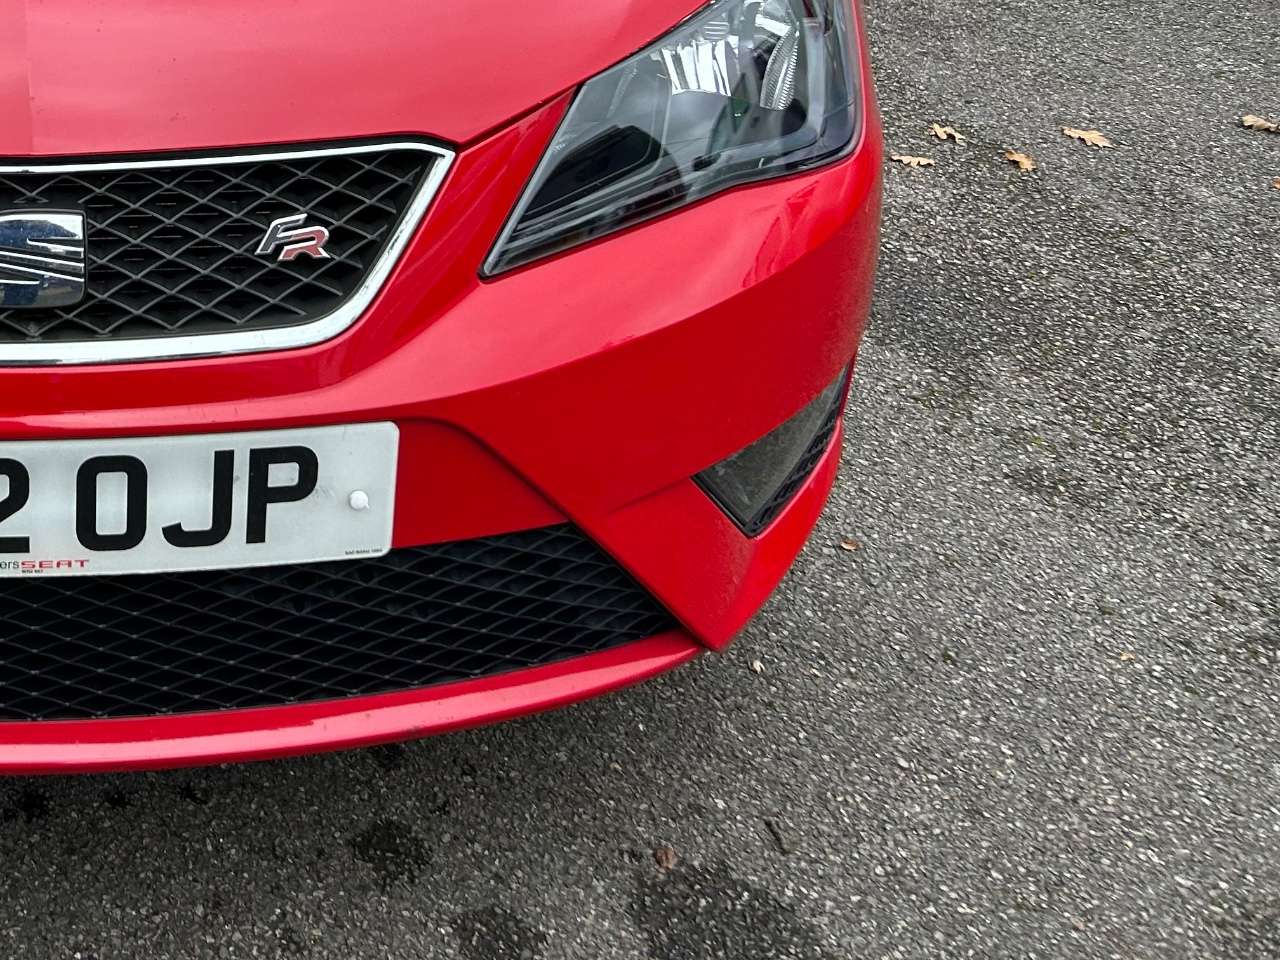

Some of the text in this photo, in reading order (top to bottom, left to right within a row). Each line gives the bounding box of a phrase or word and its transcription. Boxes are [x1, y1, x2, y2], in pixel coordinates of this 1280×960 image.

[255, 212, 332, 262] FR
[75, 445, 319, 552] OJP
[21, 559, 90, 569] SEAT
